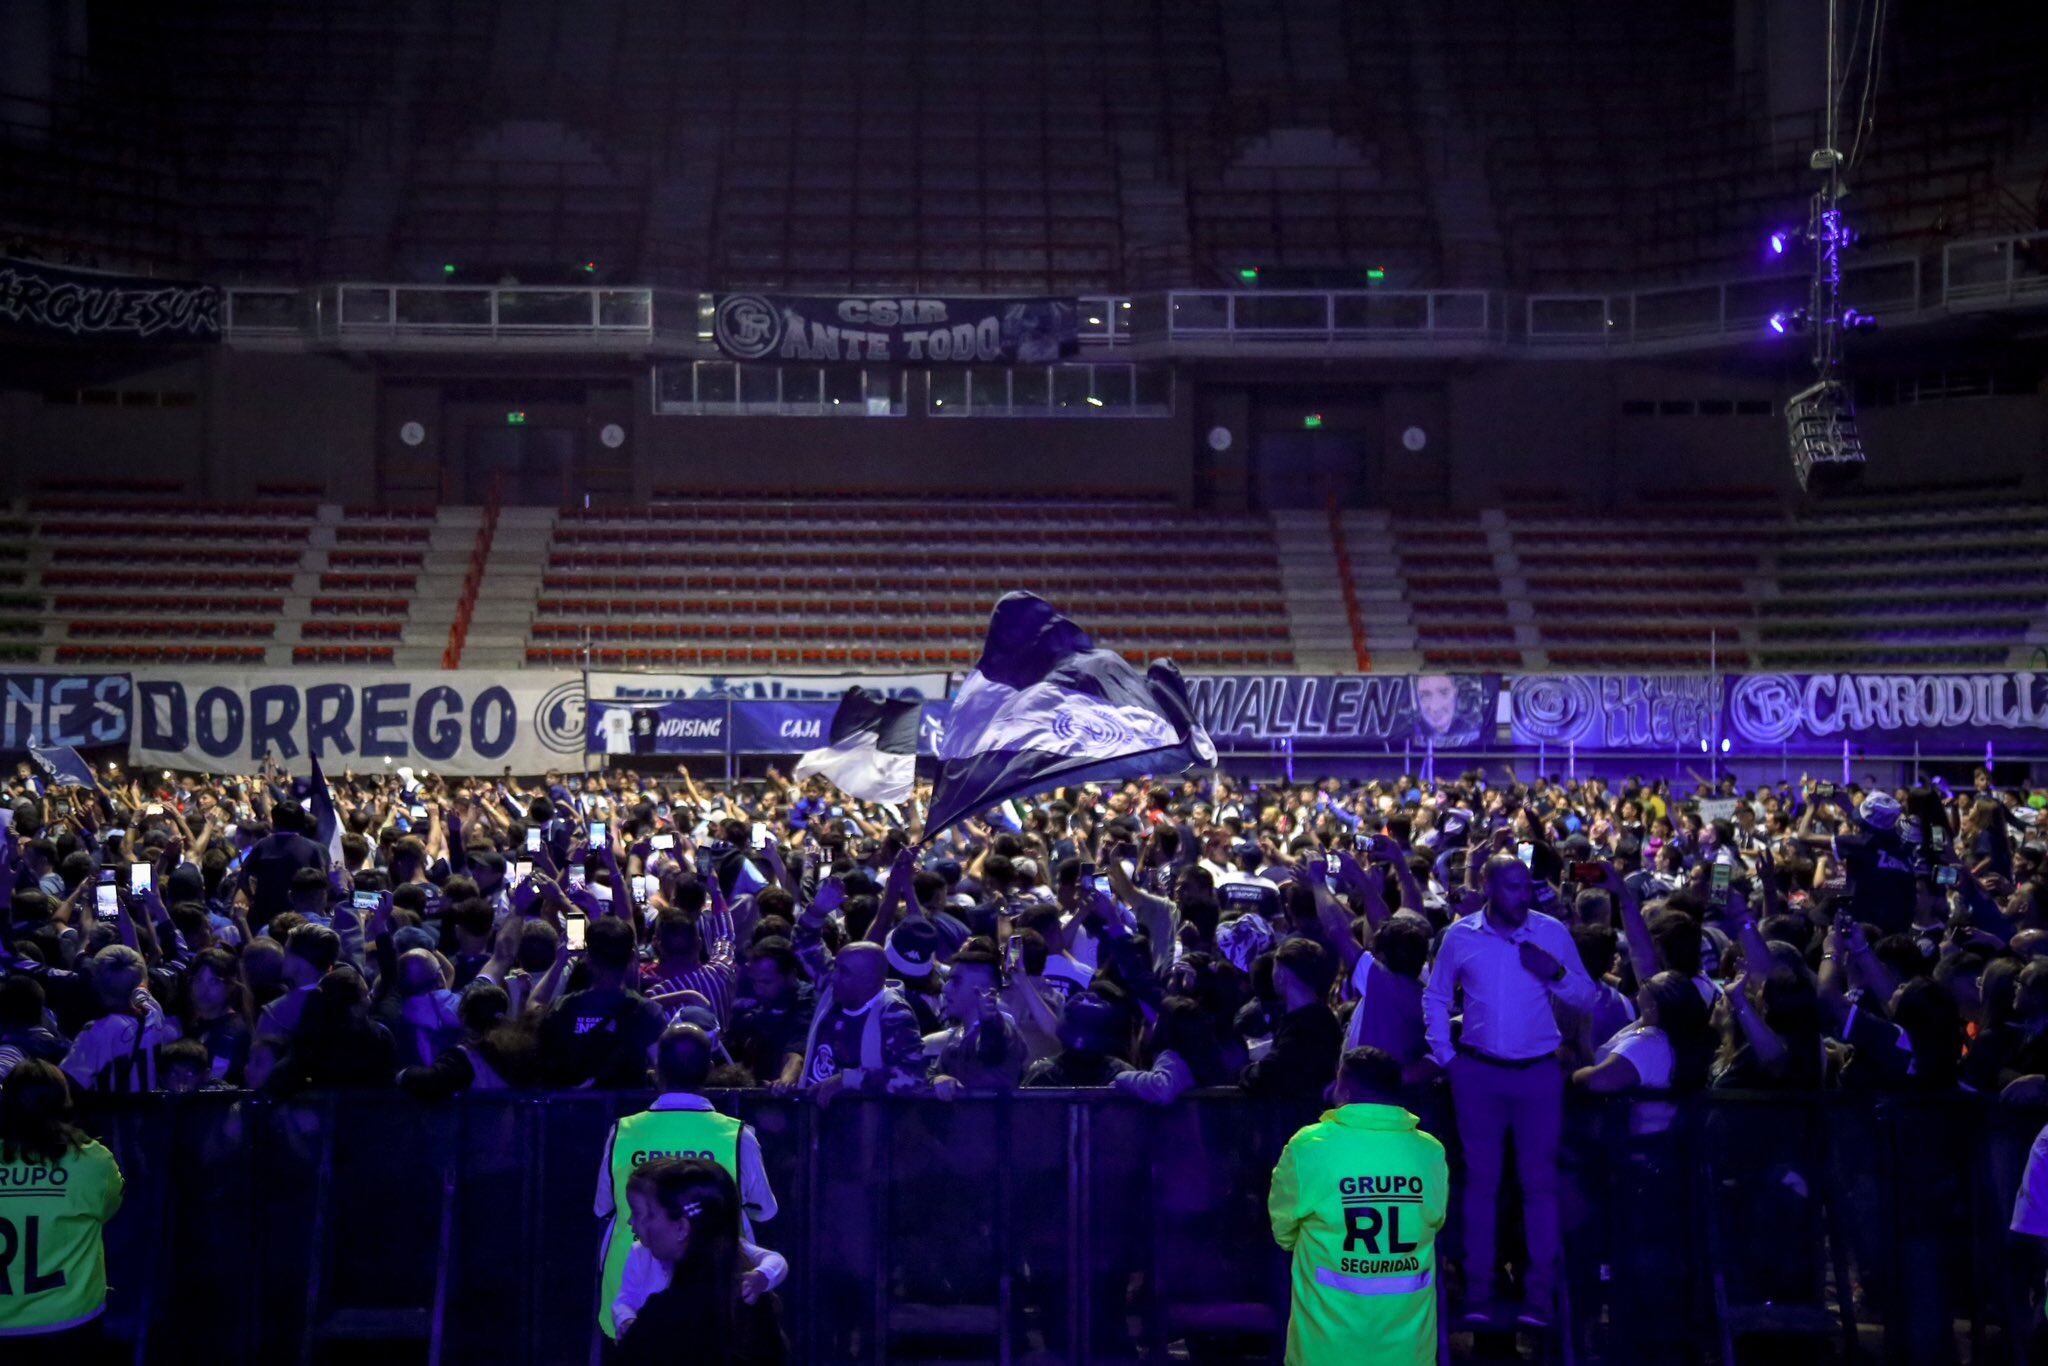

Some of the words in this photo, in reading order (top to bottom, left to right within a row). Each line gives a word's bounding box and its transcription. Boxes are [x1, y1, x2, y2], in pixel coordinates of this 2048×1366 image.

[839, 300, 950, 326] CSIR
[782, 309, 890, 360] ANTE
[903, 316, 1000, 360] TODO
[137, 681, 517, 760] DORREGO
[780, 719, 821, 738] CAJA
[1339, 1175, 1423, 1195] GRUPO
[1343, 1206, 1418, 1254] RL
[1341, 1257, 1419, 1274] SEGURIDAD
